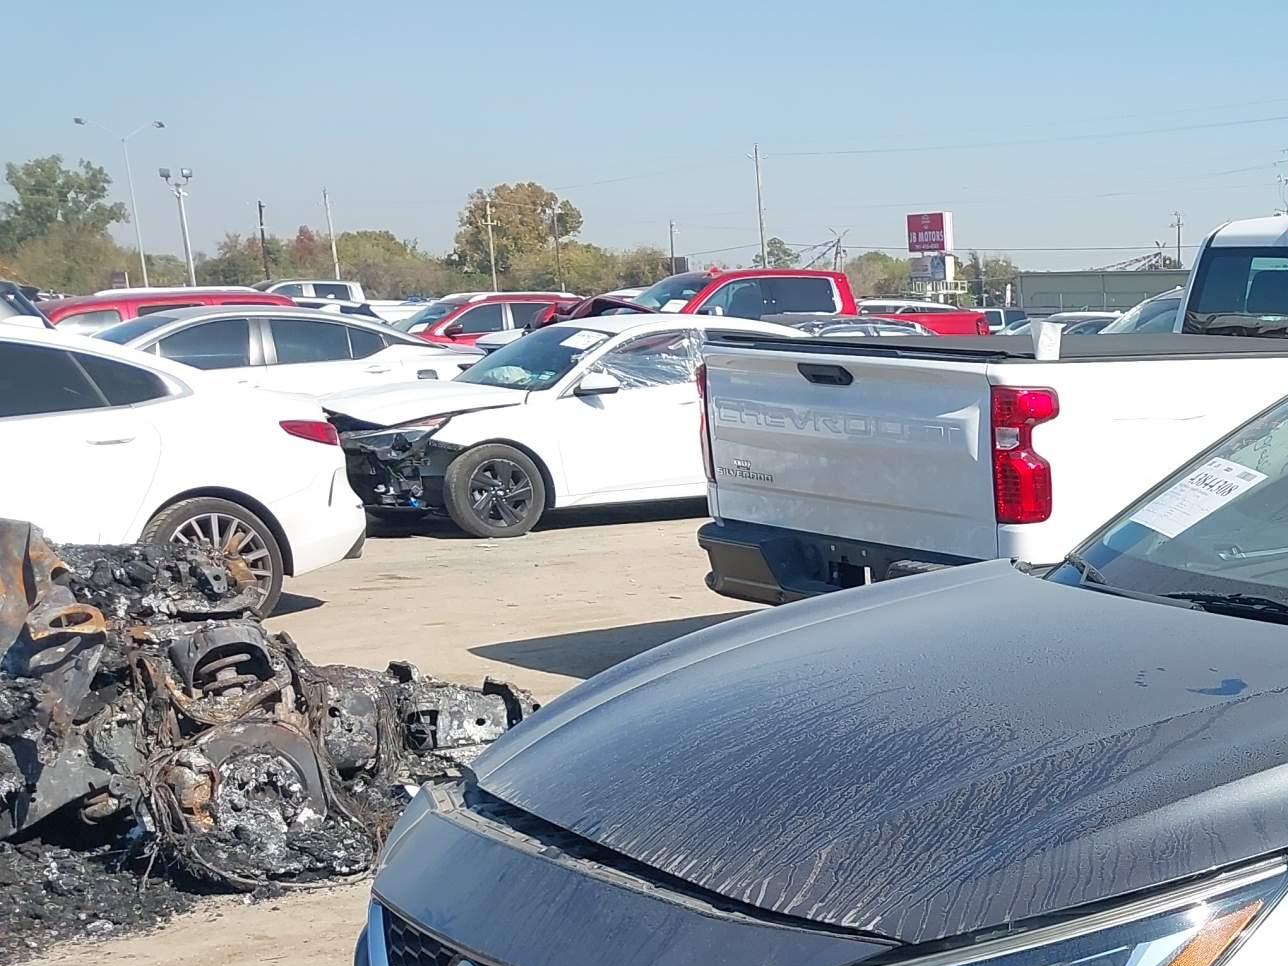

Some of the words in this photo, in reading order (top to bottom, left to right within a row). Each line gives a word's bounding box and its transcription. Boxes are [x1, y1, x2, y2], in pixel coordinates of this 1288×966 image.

[918, 229, 944, 243] MOTORS
[715, 398, 962, 443] CHEVROT
[716, 466, 774, 482] SILVERADO
